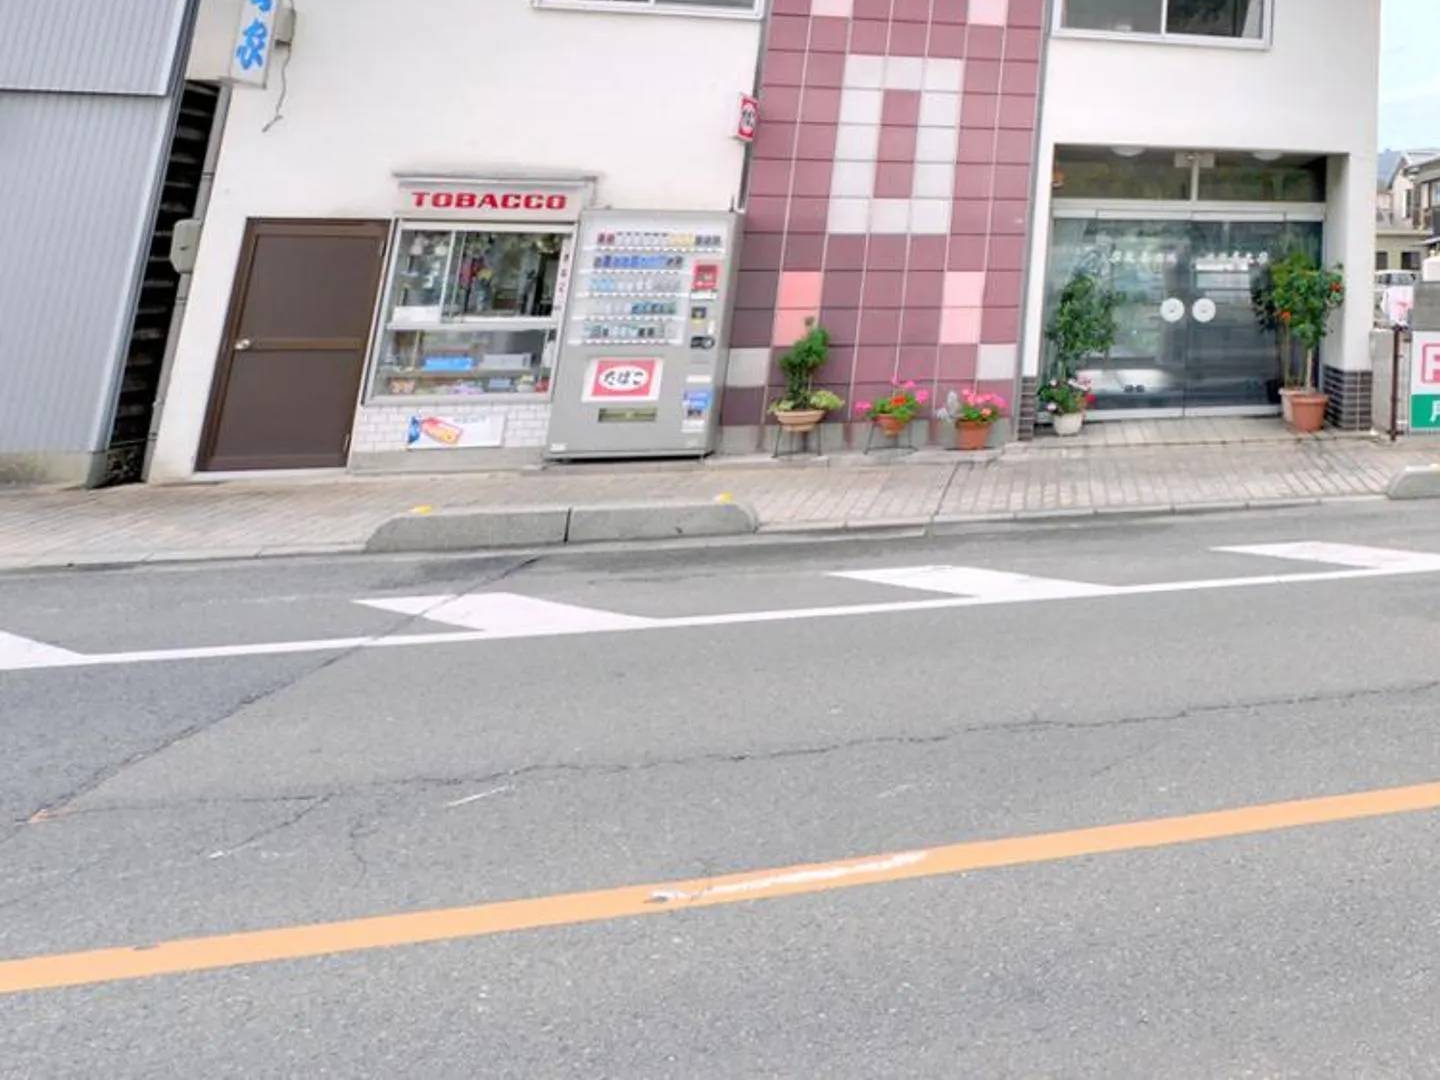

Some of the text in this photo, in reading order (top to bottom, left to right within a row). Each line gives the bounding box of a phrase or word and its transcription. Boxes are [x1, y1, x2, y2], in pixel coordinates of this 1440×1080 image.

[411, 191, 567, 210] TOBACCO
[604, 370, 645, 386] たばこ
